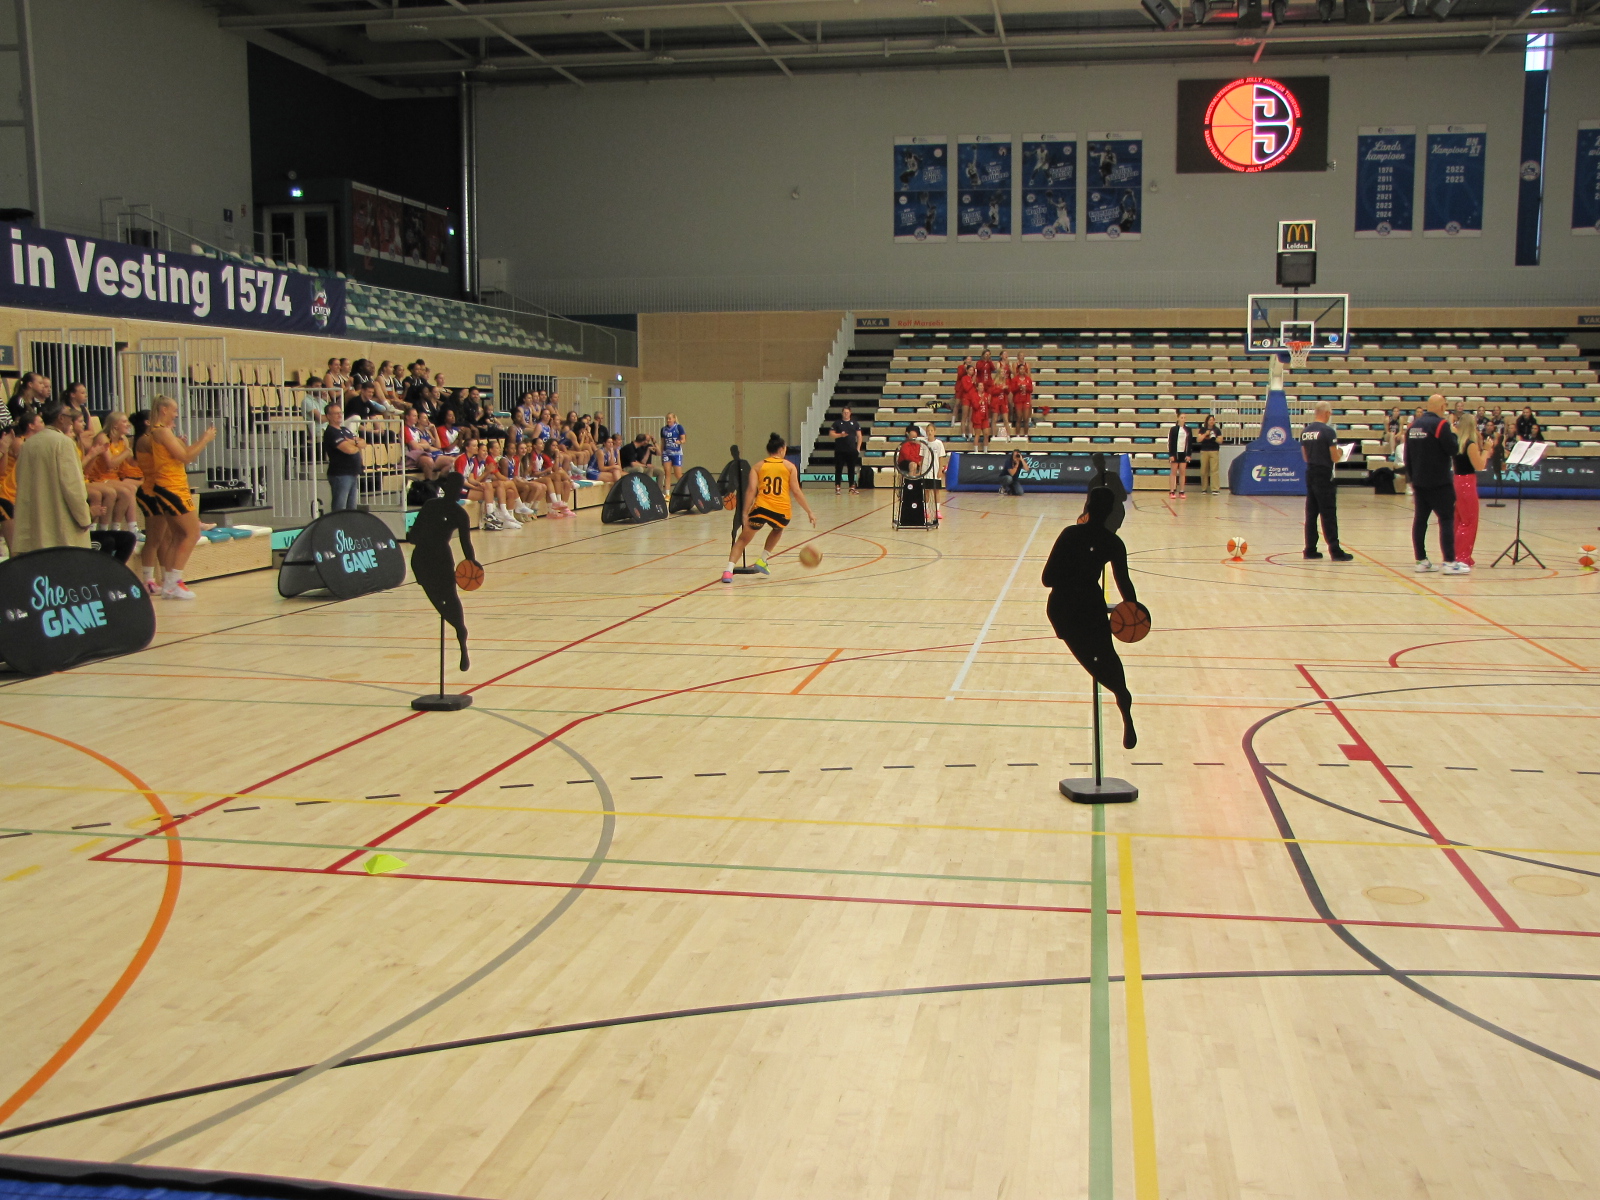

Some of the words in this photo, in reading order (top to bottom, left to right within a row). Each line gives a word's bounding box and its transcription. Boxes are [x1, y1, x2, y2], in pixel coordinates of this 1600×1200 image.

[1263, 77, 1286, 92] JUMPERS
[1373, 141, 1401, 151] Lands
[1432, 144, 1467, 156] Kampioen
[1365, 150, 1406, 162] kampioen
[11, 228, 56, 289] in
[66, 237, 211, 317] Vesting
[221, 265, 292, 316] 1574
[1301, 431, 1320, 441] CREW
[1018, 469, 1061, 481] GAME
[763, 476, 782, 495] 30
[336, 529, 356, 553] She
[355, 536, 374, 549] GOT
[342, 548, 379, 573] GAME
[31, 575, 68, 610] She
[68, 583, 101, 603] GOT
[42, 600, 108, 638] GAME
